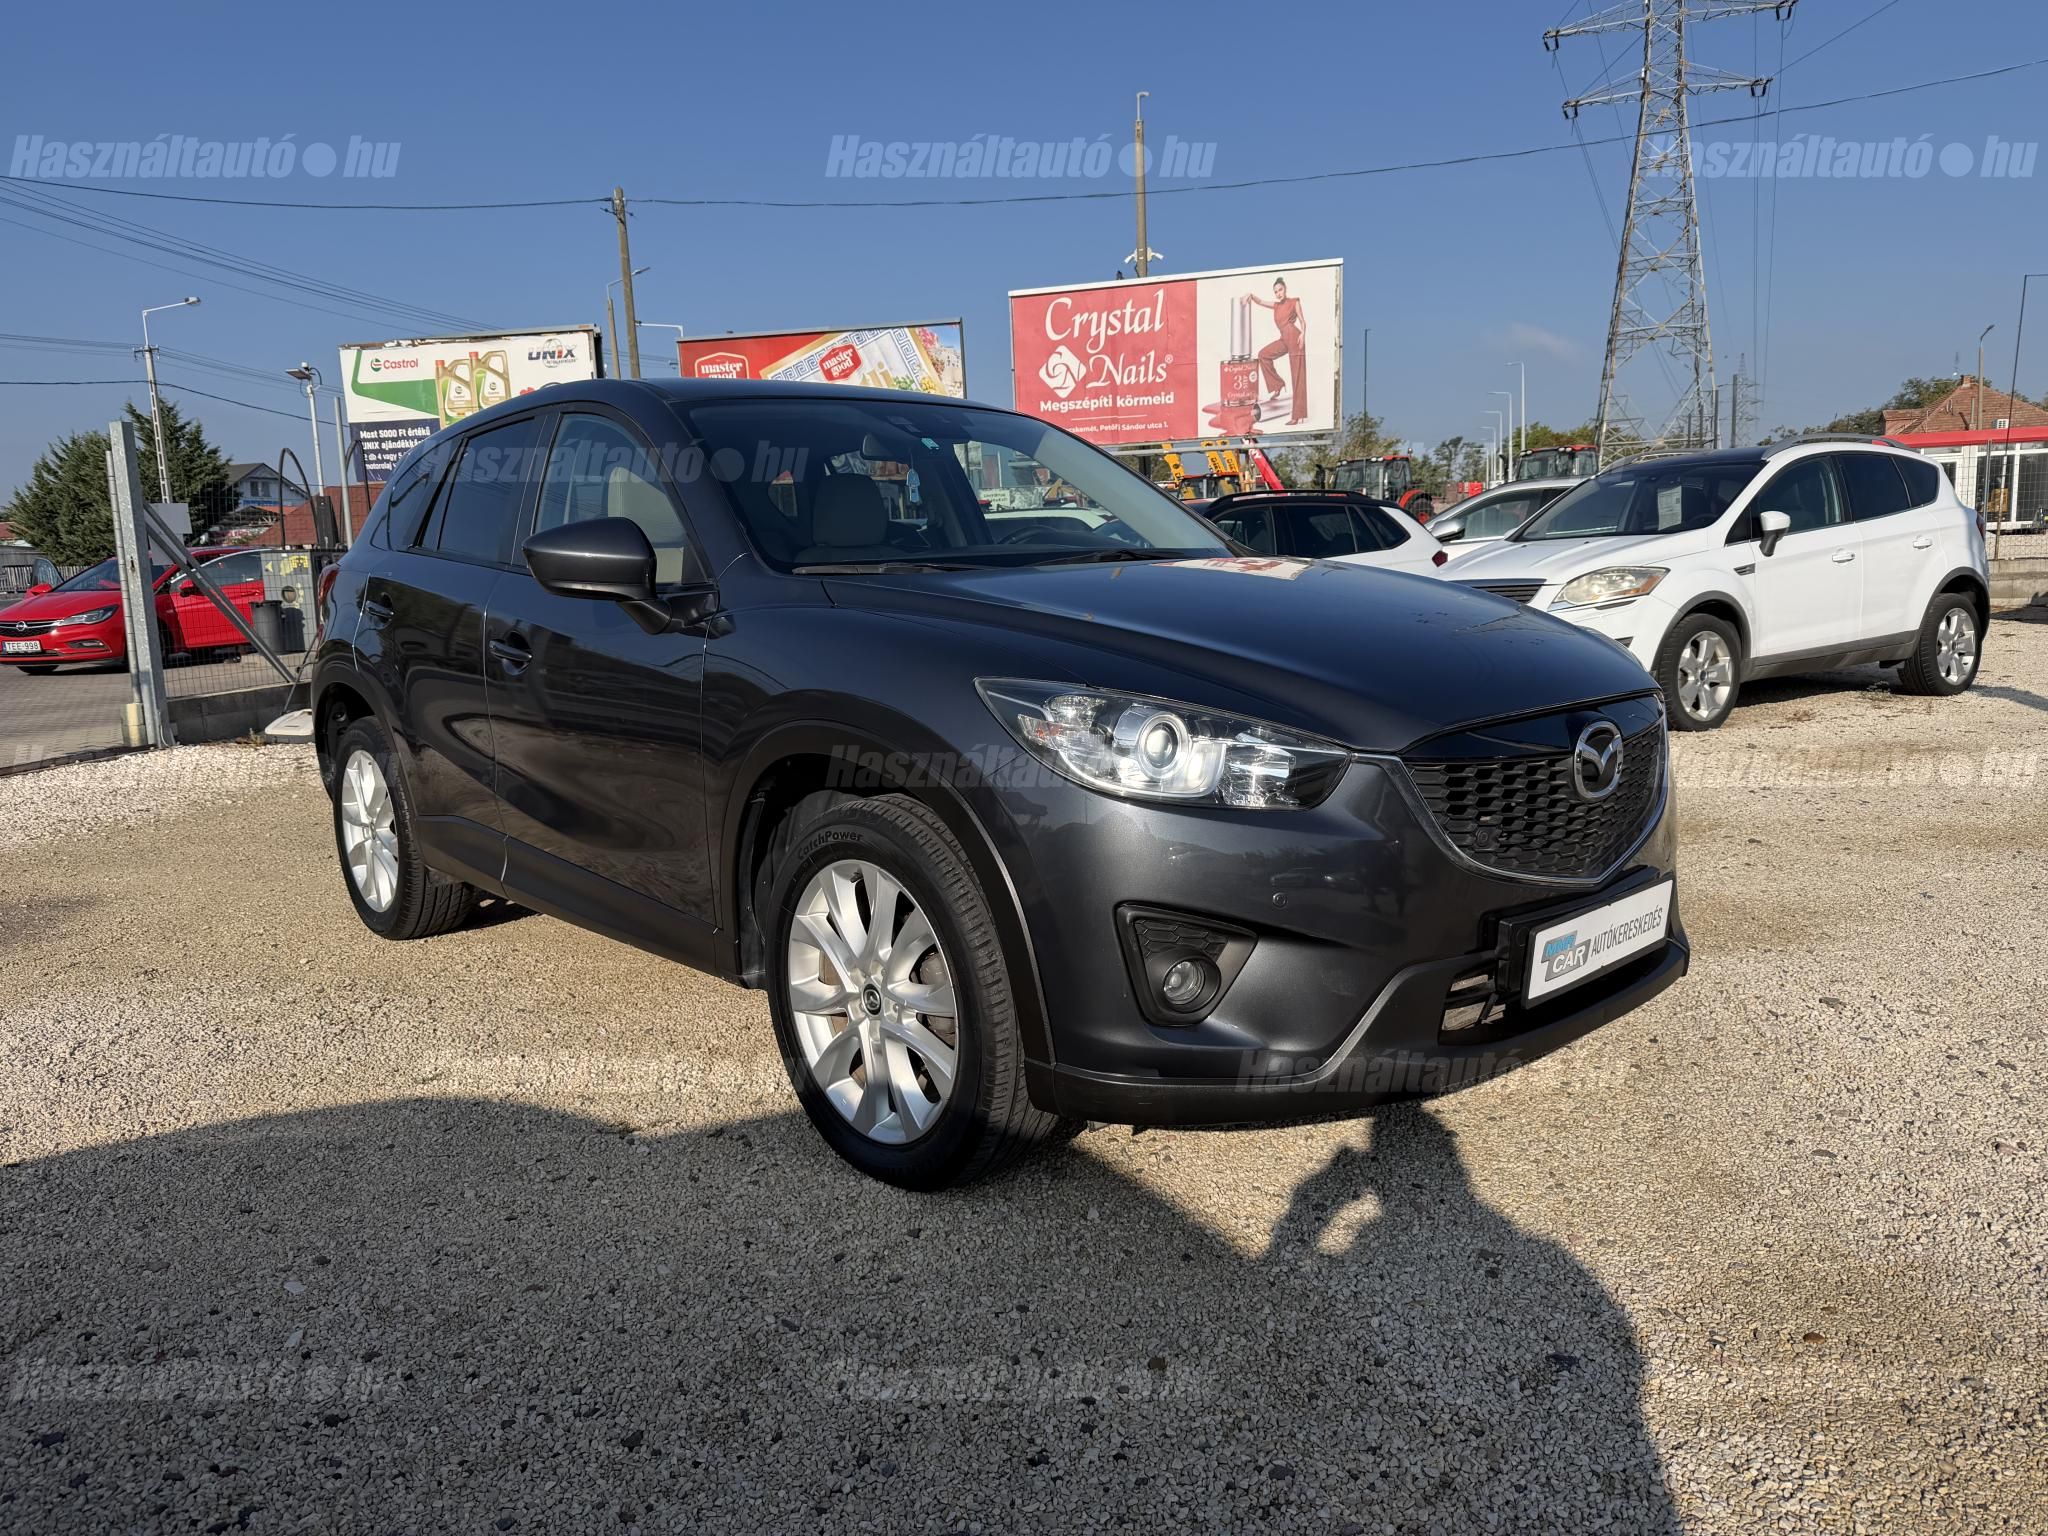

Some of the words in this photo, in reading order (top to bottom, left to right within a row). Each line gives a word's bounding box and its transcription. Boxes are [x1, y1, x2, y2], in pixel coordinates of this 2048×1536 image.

[1045, 289, 1164, 353] Crystal
[528, 346, 576, 360] UNIX
[823, 349, 853, 370] master
[383, 358, 419, 370] Castrol
[701, 361, 743, 374] master
[831, 357, 854, 378] good
[1040, 397, 1112, 413] Megszépíti
[1117, 391, 1174, 408] körmeid
[360, 430, 378, 439] Most
[379, 429, 397, 438] 5000
[398, 428, 406, 437] Ft
[1121, 423, 1146, 431] Sándor
[1553, 945, 1586, 973] CAR
[1590, 907, 1663, 958] AUTÓKERESKEDÉS
